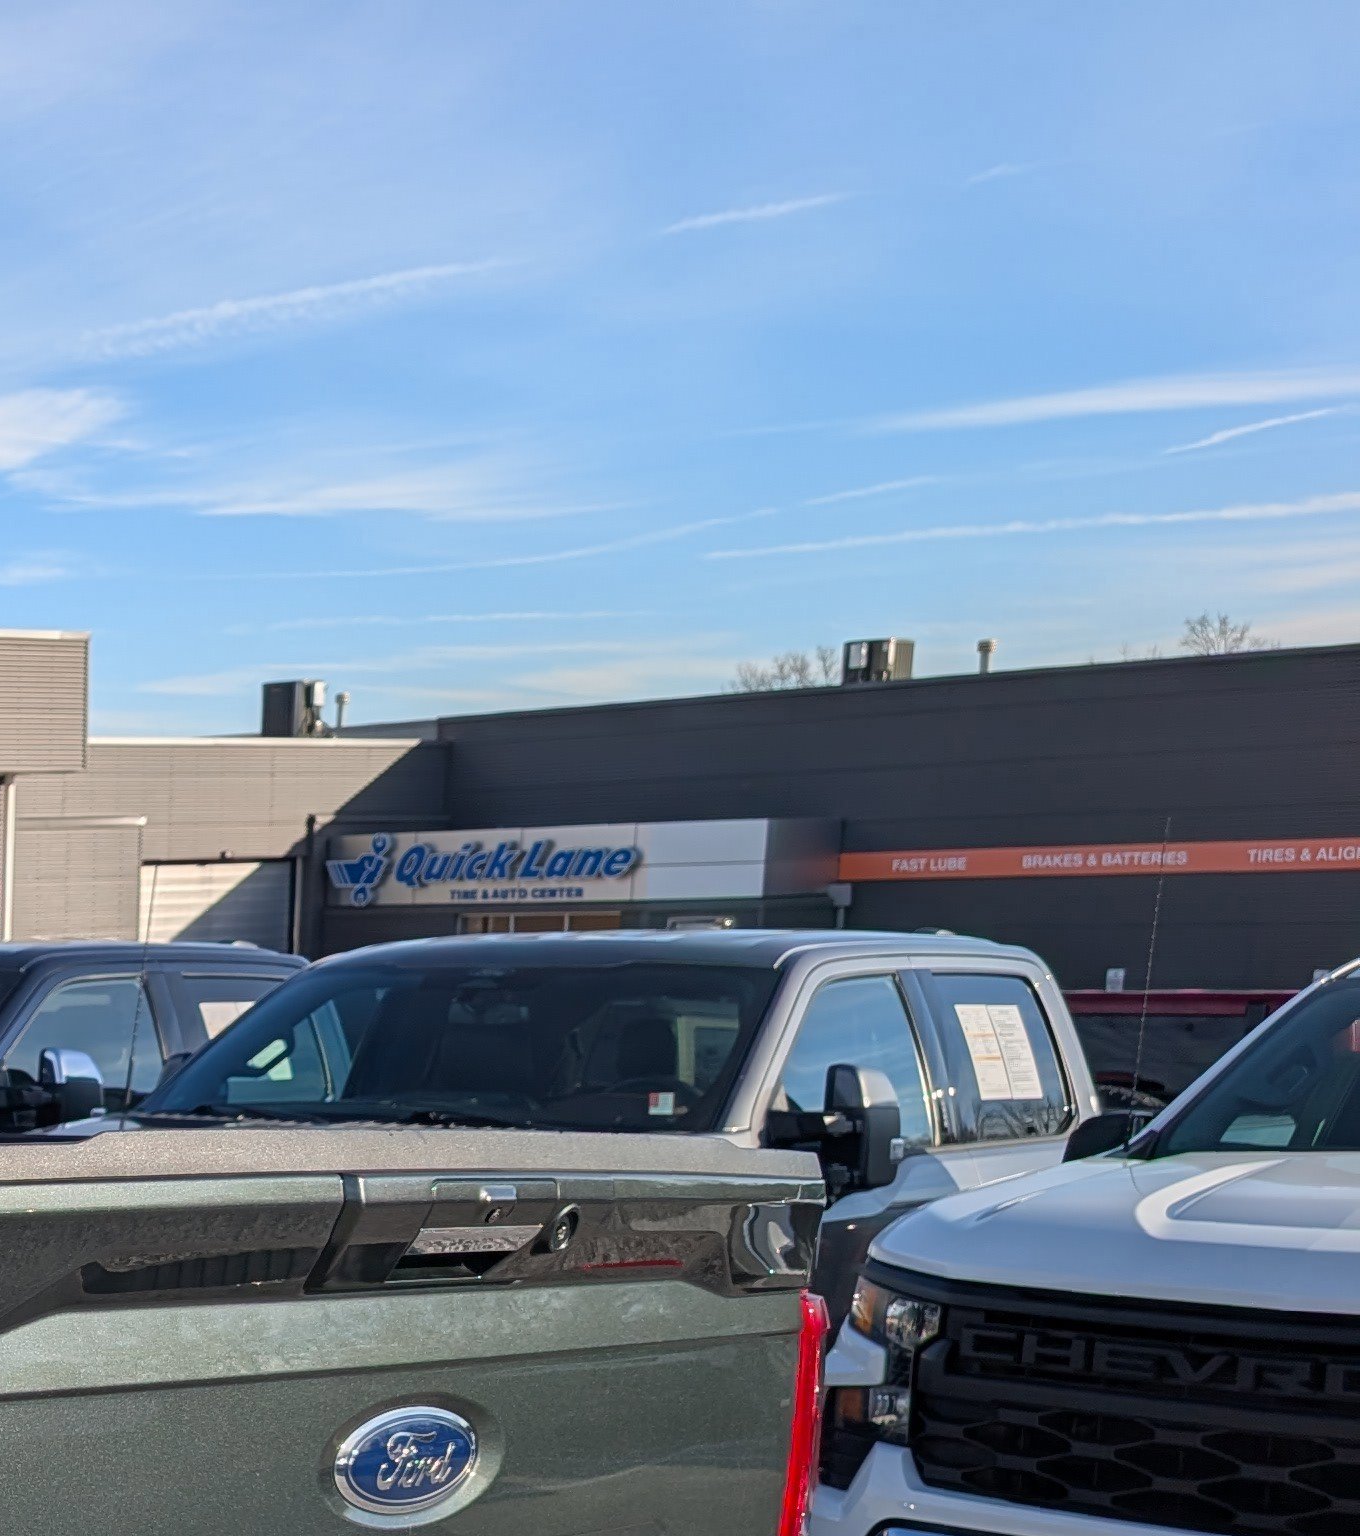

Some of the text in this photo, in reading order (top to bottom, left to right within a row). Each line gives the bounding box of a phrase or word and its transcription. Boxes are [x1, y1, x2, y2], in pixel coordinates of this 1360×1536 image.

[1022, 851, 1188, 868] BRAKES & BATTERIES
[1247, 848, 1295, 863] TIRES
[1300, 848, 1311, 861] &
[892, 856, 967, 872] FAST LUBE
[531, 886, 584, 899] CENTER
